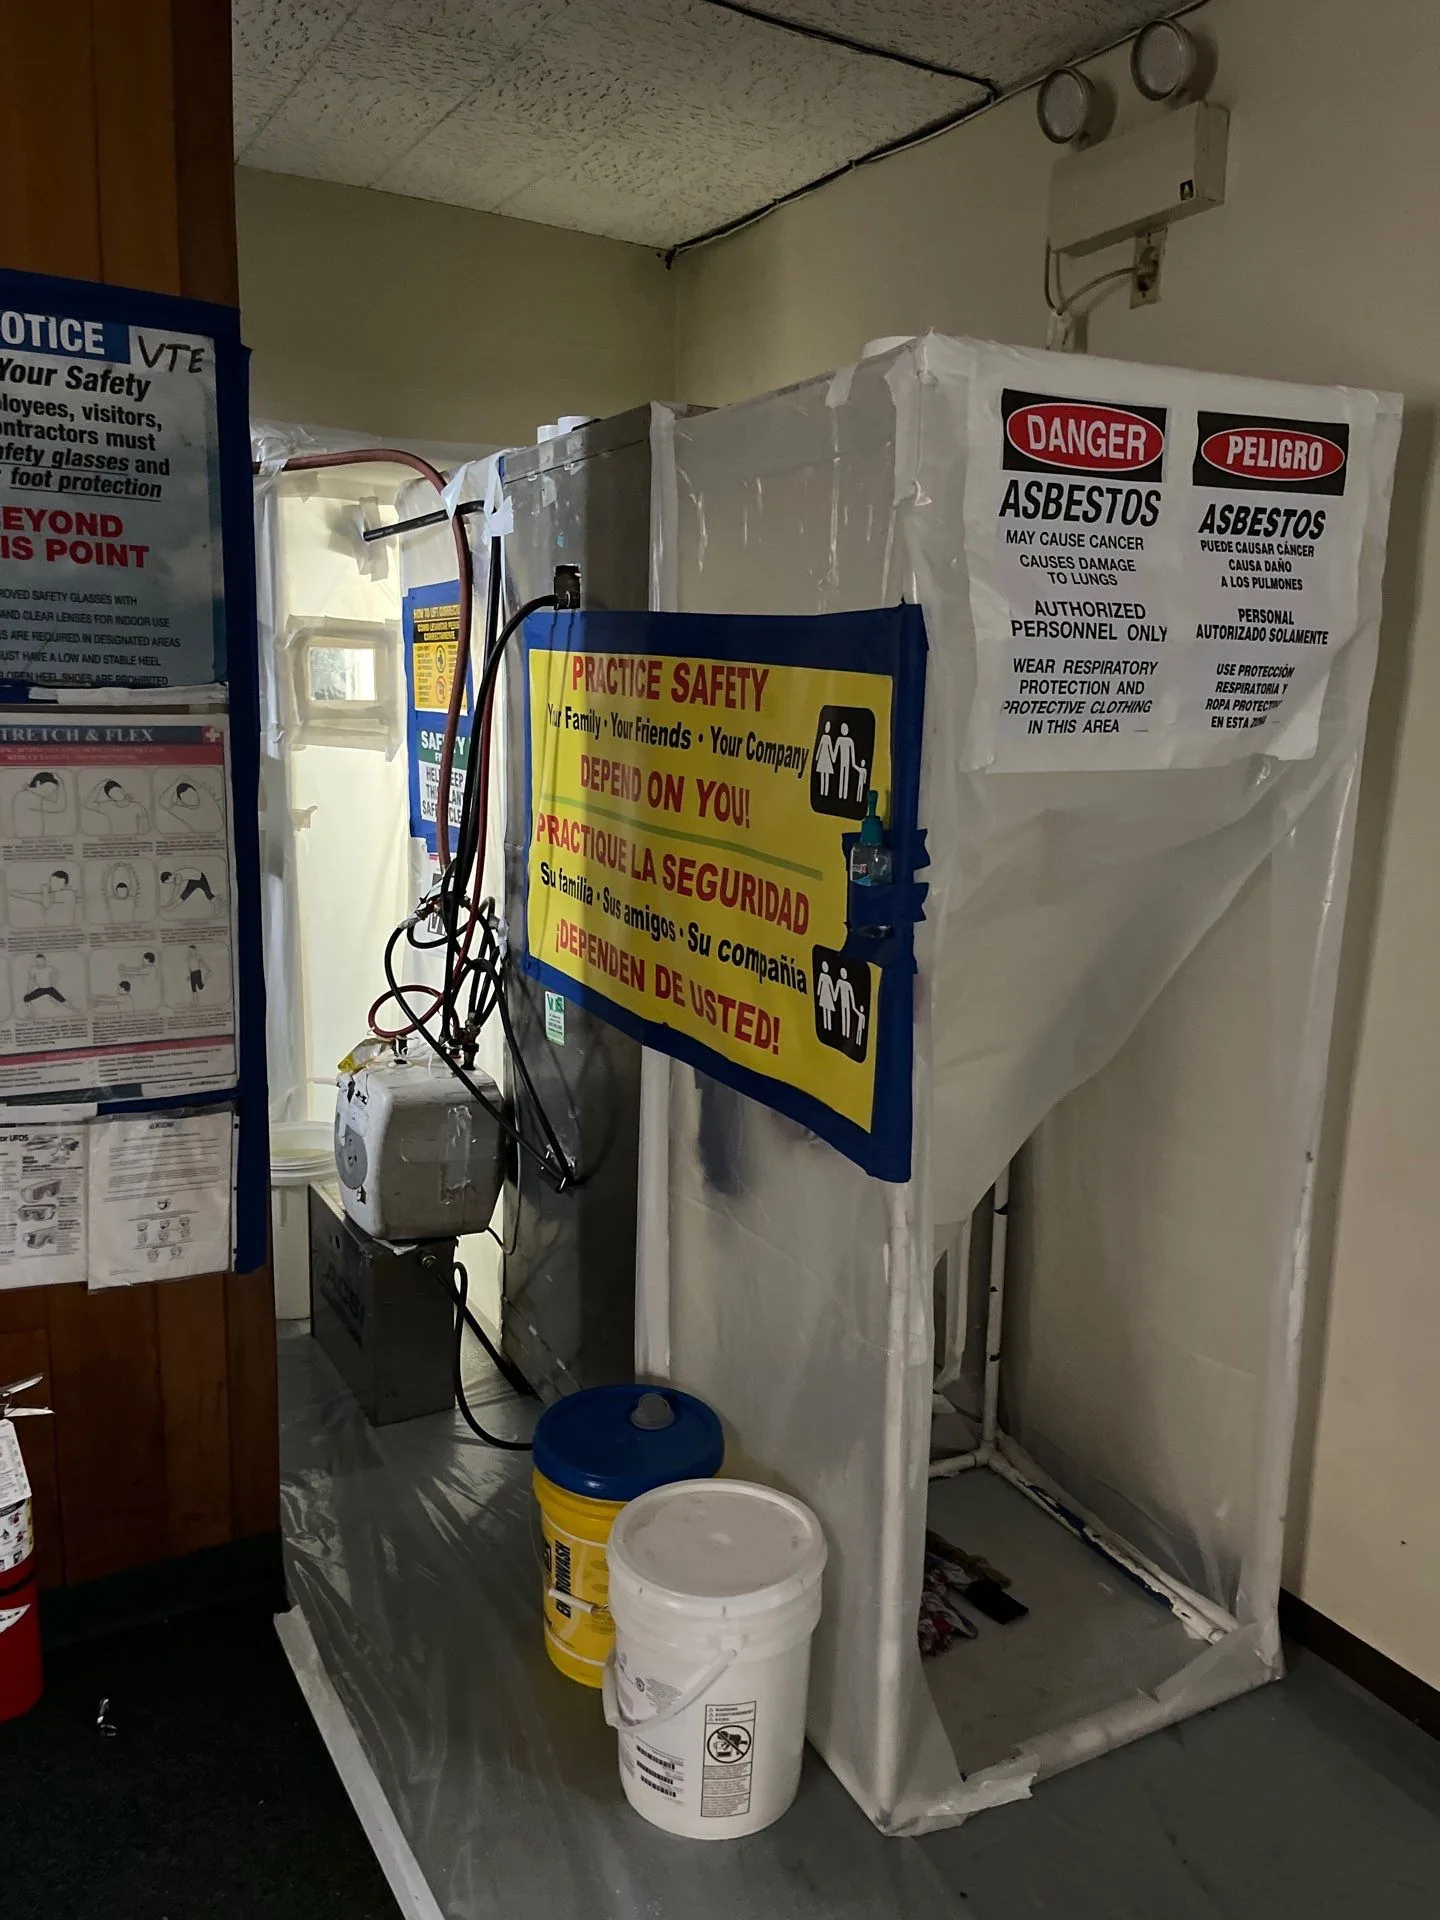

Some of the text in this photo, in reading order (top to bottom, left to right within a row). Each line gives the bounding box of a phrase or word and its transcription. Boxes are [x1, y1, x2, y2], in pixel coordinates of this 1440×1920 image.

[0, 311, 105, 355] OTICE
[138, 335, 205, 374] VTE
[65, 365, 151, 402] Safety
[0, 393, 162, 432] loyees, visitors,
[106, 432, 156, 451] must
[1027, 414, 1147, 461] DANGER
[51, 448, 130, 471] glasses
[135, 458, 170, 476] and
[1226, 435, 1323, 472] PELIGRO
[11, 467, 162, 498] foot protection
[999, 479, 1162, 527] ASBESTOS
[1, 506, 124, 538] EYOND
[1198, 504, 1326, 540] ASBESTOS
[1006, 529, 1144, 550] MAY CAUSE CANCER
[1200, 540, 1315, 557] PUEDE CAUSAR CÁNCER
[0, 535, 149, 568] IS POINT
[1019, 554, 1137, 571] CAUSES DAMAGE
[1229, 558, 1292, 572] CAUSA DAÑO
[1047, 572, 1118, 586] TO LUNGS
[1221, 576, 1303, 590] A LOS PULMONES
[32, 590, 67, 602] SAFETY
[70, 592, 112, 605] GLASSES
[114, 595, 137, 606] WITH
[23, 611, 53, 622] CLEAR
[56, 612, 92, 624] LENSES
[95, 615, 113, 625] FOR
[115, 615, 150, 627] INDOOR
[152, 617, 170, 628] USE
[1034, 600, 1146, 620] AUTHORIZED
[1238, 608, 1295, 625] PERSONAL
[10, 631, 29, 641] ARE
[32, 632, 80, 644] REQUIRED
[82, 634, 92, 645] IN
[94, 634, 149, 647] DESIGNATED
[152, 637, 181, 648] AREAS
[1011, 620, 1168, 642] PERSONNEL ONLY
[1196, 624, 1329, 645] AUTORIZADO SOLAMENTE
[23, 651, 47, 662] HAVE
[50, 652, 57, 662] A
[58, 653, 79, 663] LOW
[82, 653, 101, 665] AND
[103, 655, 136, 666] STABLE
[138, 656, 161, 667] HEEL
[1013, 658, 1159, 675] WEAR RESPIRATORY
[1216, 663, 1295, 678] USE PROTECCIÓN
[572, 655, 770, 712] PRACTICE SAFETY
[1019, 679, 1145, 695] PROTECTION AND
[1215, 681, 1289, 695] RESPIRATORIA Y
[1090, 700, 1153, 714] CLOTHING
[1205, 698, 1231, 711] ROPA
[1027, 719, 1120, 734] IN THIS AREA
[1211, 716, 1224, 728] EN
[1226, 716, 1249, 729] ESTA
[0, 728, 153, 743] TRETCH & FLEX
[420, 730, 465, 755] SAFTY
[565, 706, 601, 740] Family
[611, 712, 633, 740] Your
[635, 716, 692, 750] Friends
[710, 725, 743, 758] Your
[746, 731, 810, 779] Company
[426, 766, 464, 788] HEL EEP
[580, 754, 750, 829] DEPEND ON YOU!
[536, 813, 810, 936] PRACTIQUE LA SEGURIDAD
[540, 861, 808, 995] Su familia Sus amigos Su compañía
[655, 963, 686, 1008] DE
[689, 979, 780, 1056] USTED!
